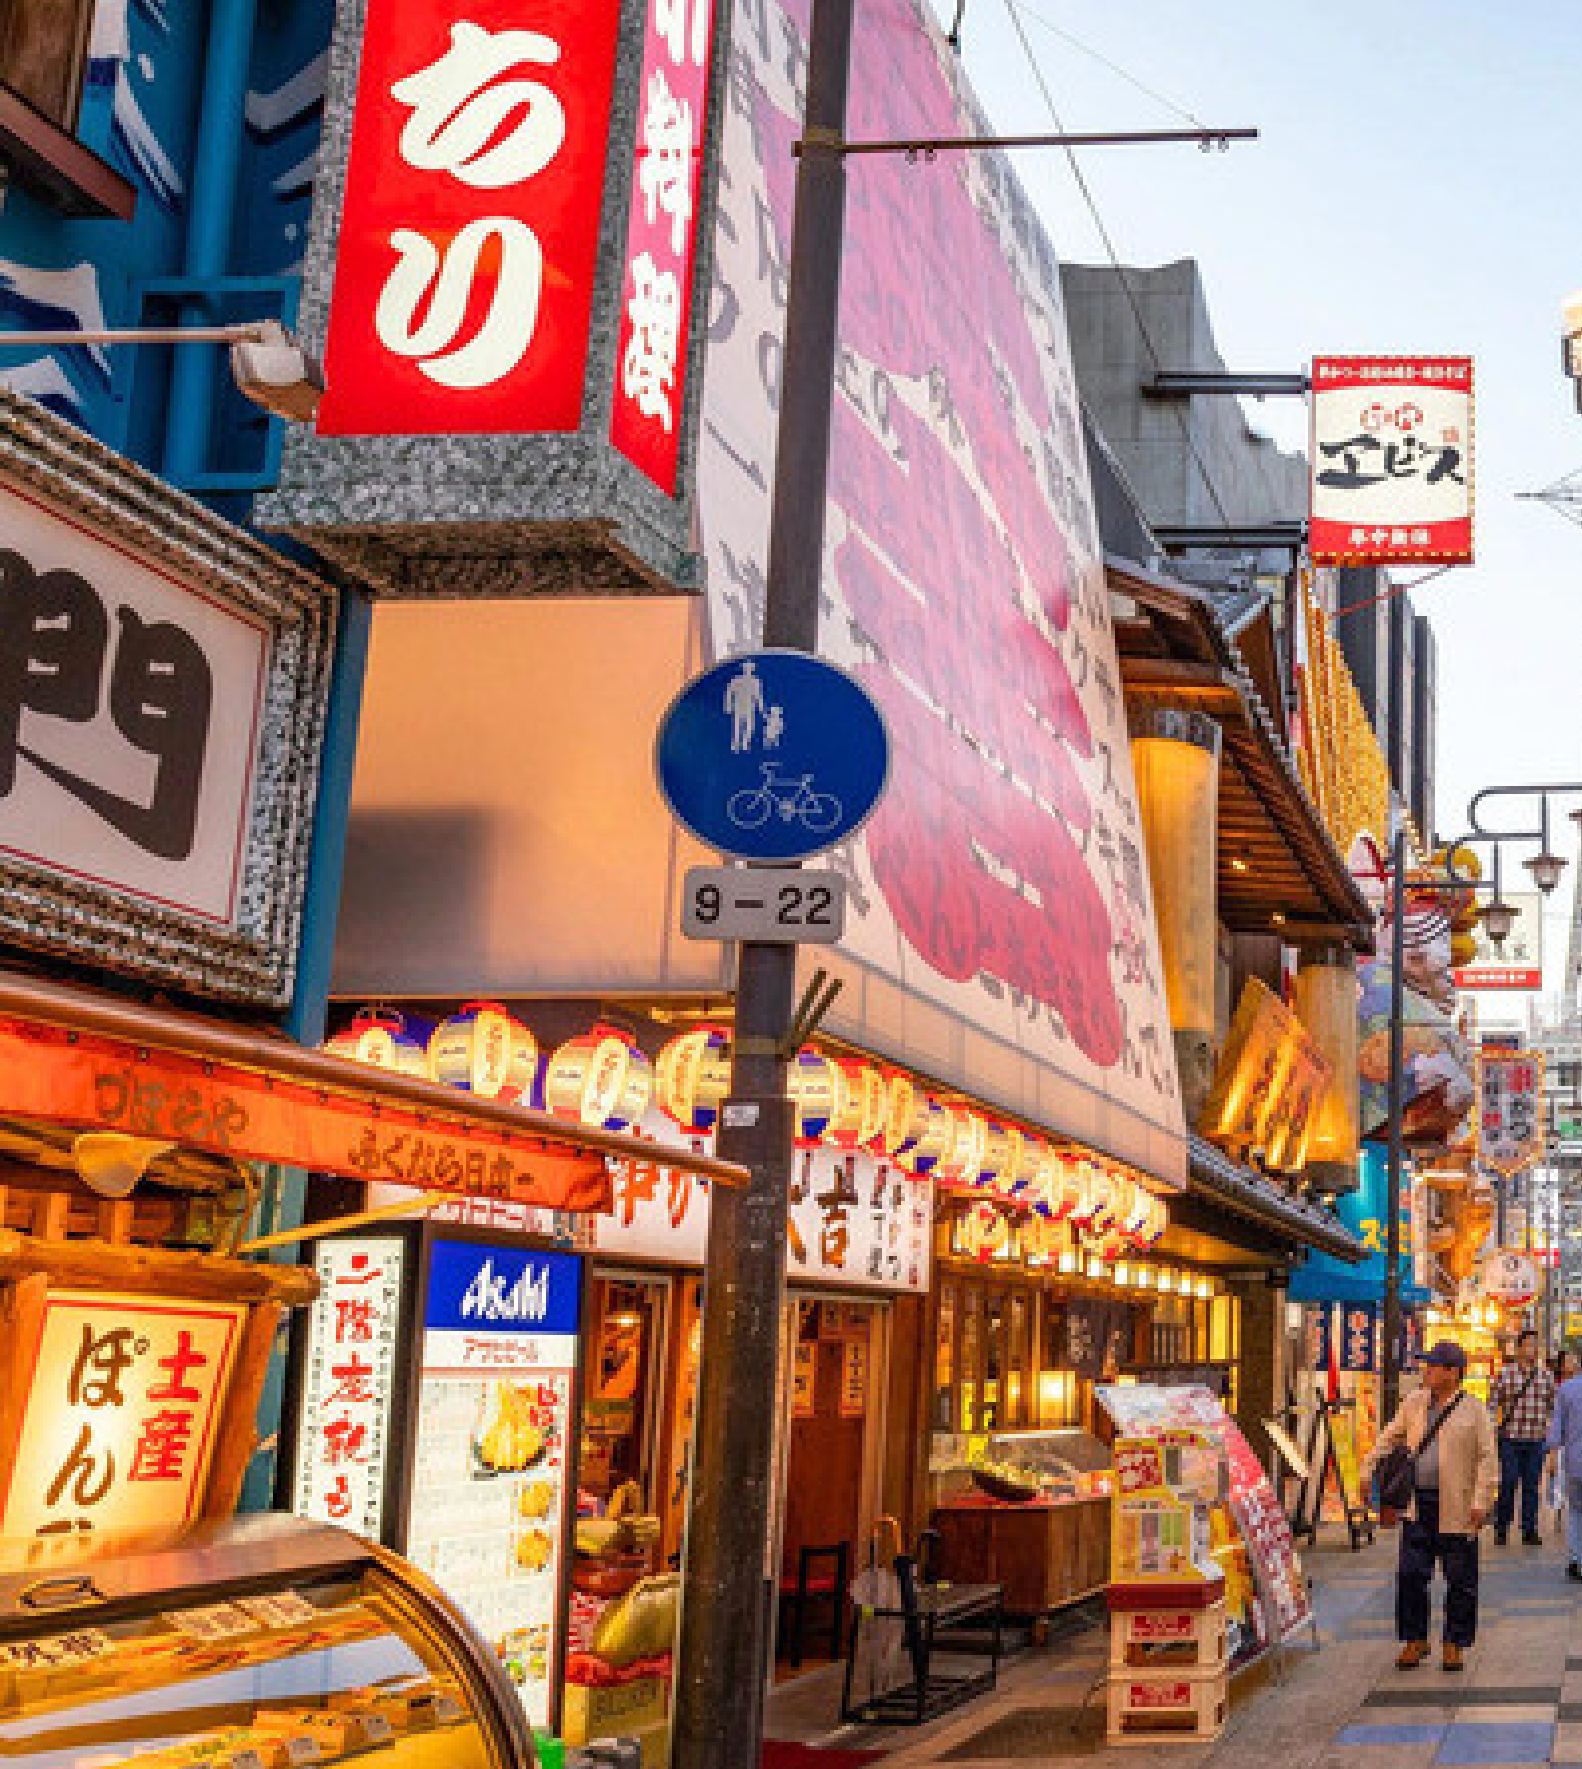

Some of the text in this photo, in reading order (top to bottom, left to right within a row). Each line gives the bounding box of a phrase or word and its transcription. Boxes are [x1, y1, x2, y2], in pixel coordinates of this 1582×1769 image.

[1315, 433, 1466, 489] エビス
[458, 1255, 551, 1324] Asahi
